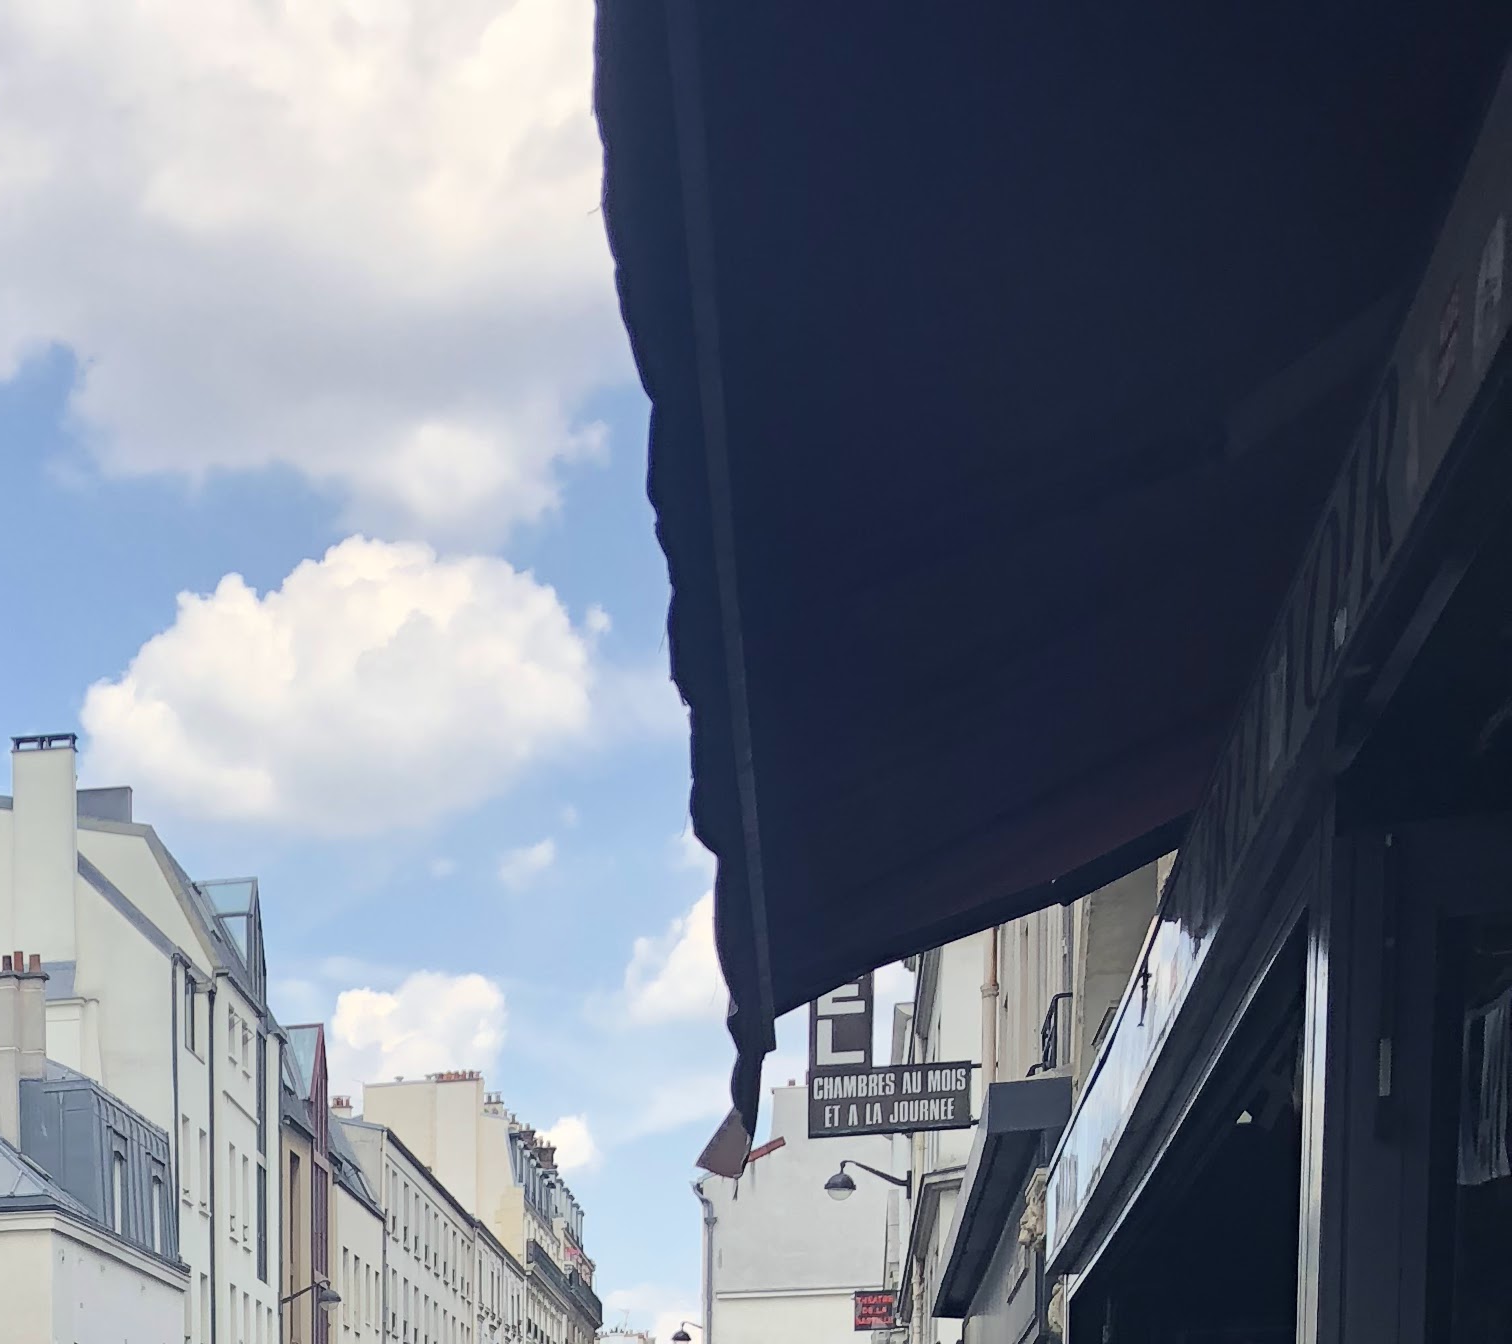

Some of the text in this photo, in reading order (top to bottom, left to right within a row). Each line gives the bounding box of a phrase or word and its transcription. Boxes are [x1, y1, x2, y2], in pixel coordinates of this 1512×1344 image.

[813, 1068, 967, 1100] CHAMBRES AU MOIS
[824, 1098, 955, 1128] ET A LA JOURNEE
